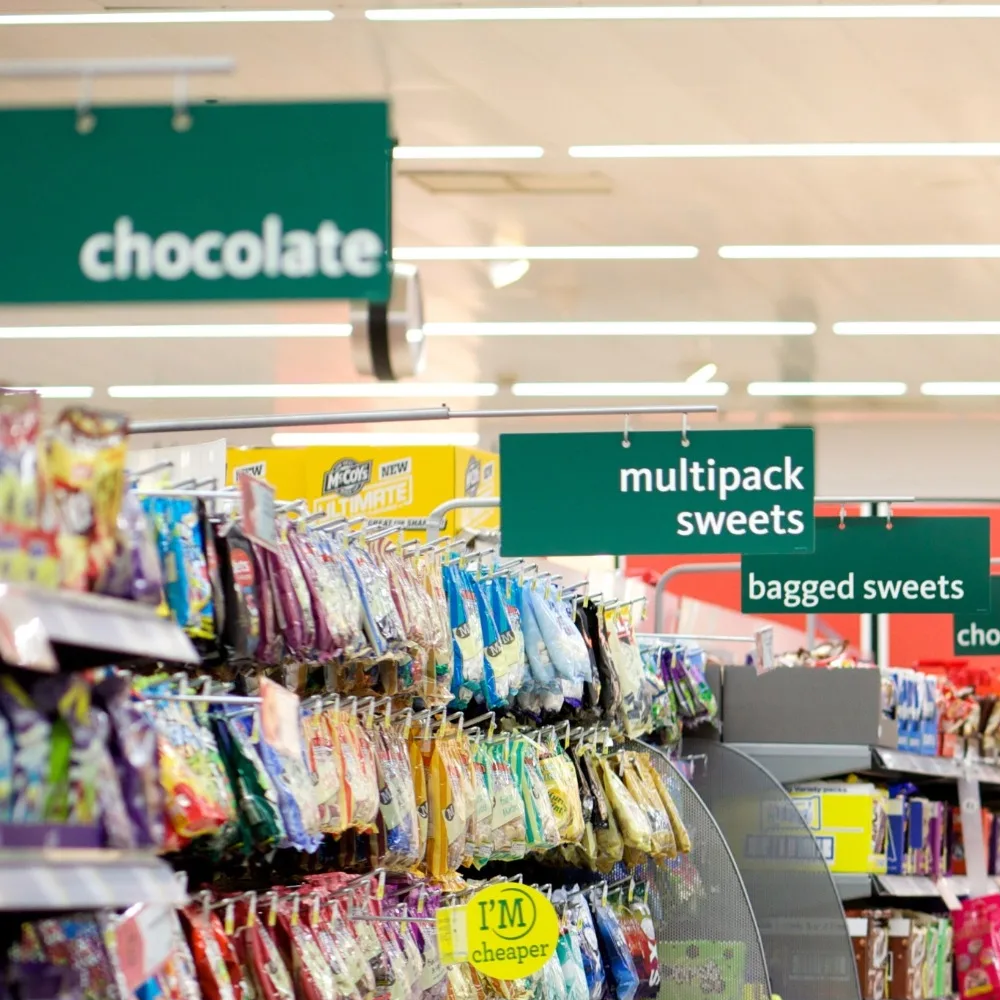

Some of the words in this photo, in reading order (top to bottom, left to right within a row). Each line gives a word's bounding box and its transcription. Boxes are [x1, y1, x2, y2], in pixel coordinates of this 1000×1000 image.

[80, 214, 382, 281] chocolate
[381, 461, 409, 477] NEW
[619, 455, 804, 501] multipack
[676, 504, 805, 537] sweets
[748, 573, 854, 608] bagged
[863, 574, 965, 602] sweets
[478, 898, 526, 931] I'M
[472, 941, 549, 965] cheaper
